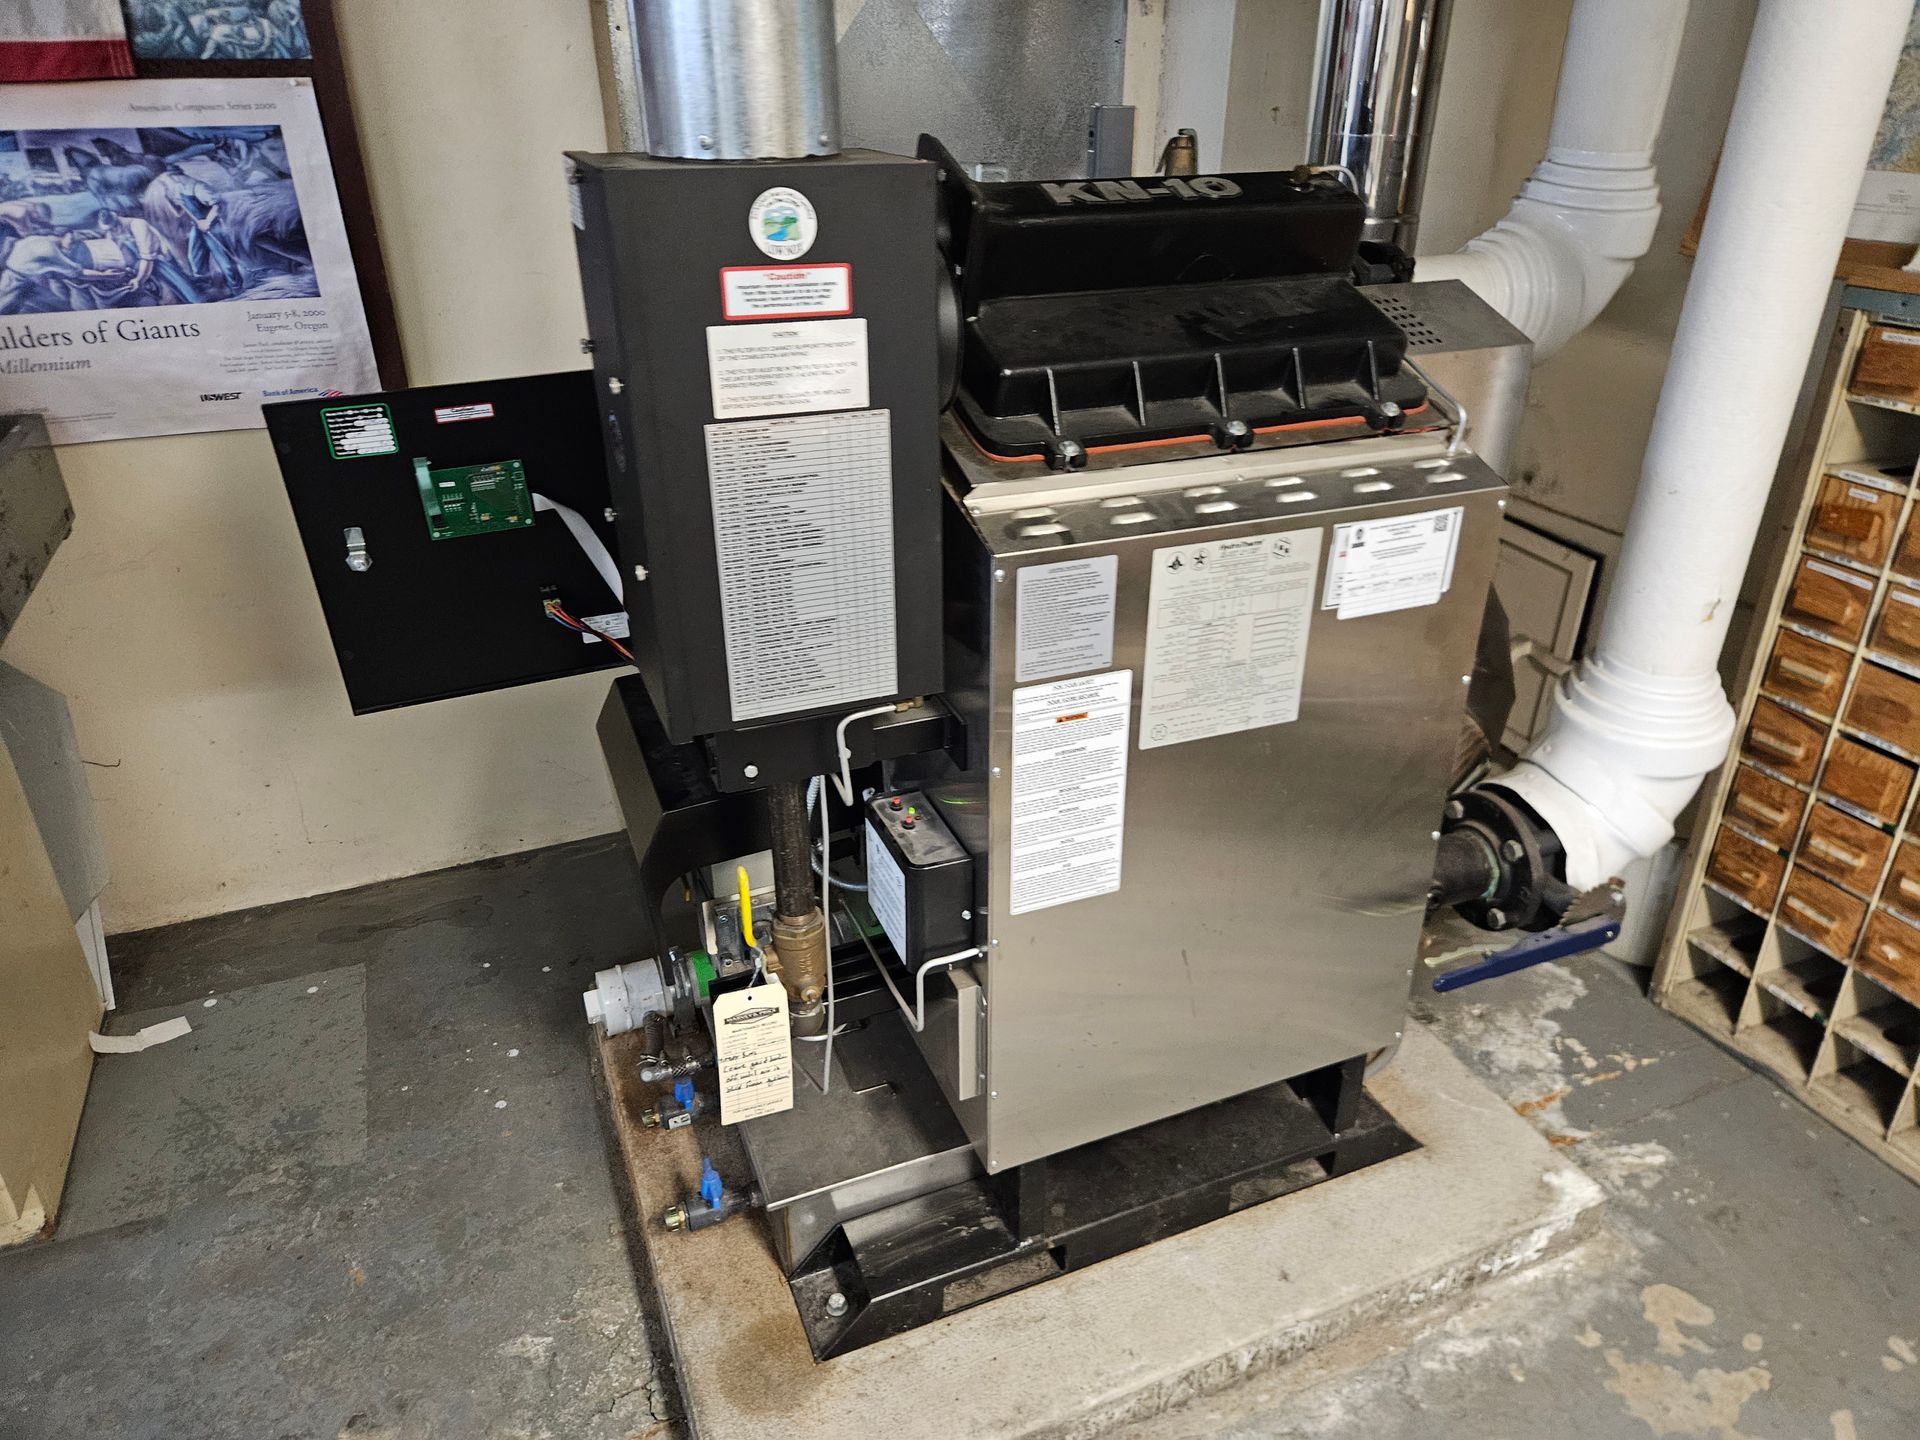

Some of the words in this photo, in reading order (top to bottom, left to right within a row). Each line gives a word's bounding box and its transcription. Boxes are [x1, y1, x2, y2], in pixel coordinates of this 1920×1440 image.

[1040, 176, 1243, 206] KN-10
[247, 311, 281, 321] January
[82, 320, 108, 345] of
[116, 319, 201, 342] Giants
[294, 321, 329, 332] Oregon
[290, 387, 318, 395] America
